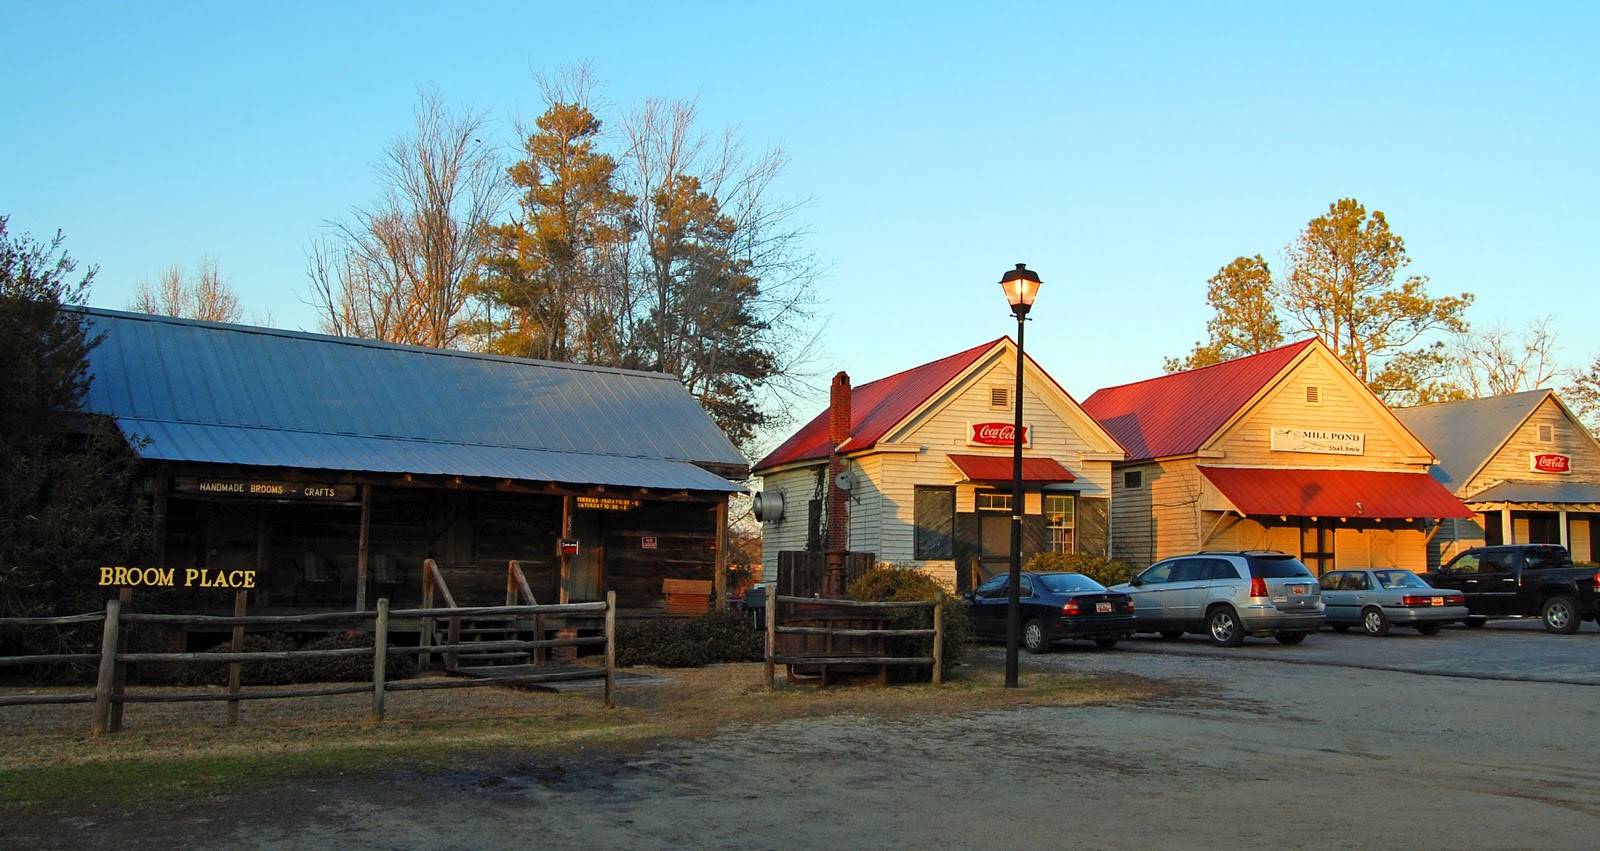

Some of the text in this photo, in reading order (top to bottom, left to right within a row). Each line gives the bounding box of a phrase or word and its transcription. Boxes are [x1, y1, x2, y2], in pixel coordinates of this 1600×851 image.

[1303, 431, 1360, 442] MILL POND
[1539, 456, 1565, 467] Coca-Cola
[200, 483, 244, 492] HANDMADE
[250, 485, 283, 494] BROOMS
[304, 488, 335, 497] CRAFTS
[98, 566, 256, 588] BROOM PLACE
